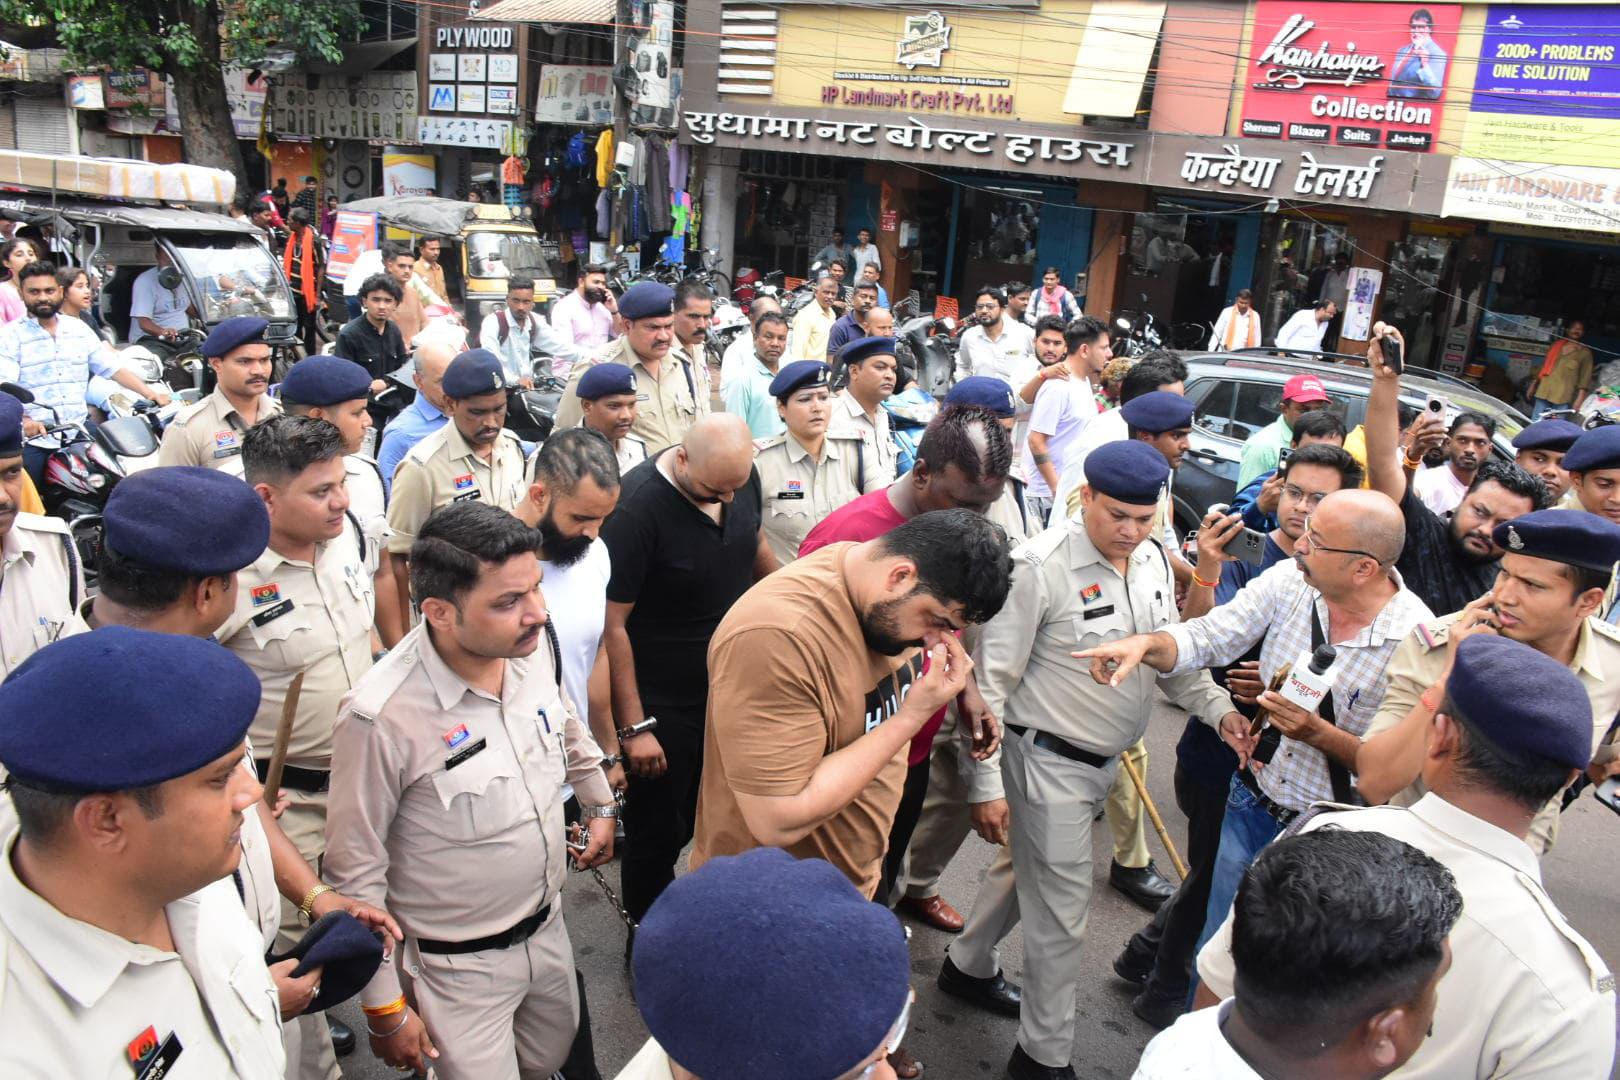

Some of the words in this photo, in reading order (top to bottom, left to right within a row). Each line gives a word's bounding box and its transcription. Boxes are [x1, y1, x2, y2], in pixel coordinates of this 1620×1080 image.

[437, 27, 512, 48] PLYWOOD
[1256, 14, 1385, 87] Kanhaiya
[1495, 43, 1538, 58] 2000+
[1540, 44, 1615, 61] PROBLEMS
[1492, 63, 1520, 78] ONE
[1522, 64, 1591, 81] SOLUTION
[821, 86, 840, 104] HP
[842, 86, 908, 108] Landmark
[911, 90, 949, 110] Craft
[953, 92, 984, 112] Pvt.
[988, 93, 1013, 114] Ltd
[1311, 94, 1432, 125] Collection
[1242, 121, 1281, 134] Sherwani
[1289, 124, 1328, 138] Blazer
[1343, 128, 1372, 142] Suits
[684, 110, 809, 145] सुधामा
[815, 119, 877, 145] नट
[886, 116, 995, 154] बोल्ट
[1005, 133, 1136, 167] हाउस
[1390, 134, 1426, 145] Jacket
[1180, 144, 1282, 191] कन्हैया
[1294, 151, 1384, 199] टेलर्स
[1495, 175, 1608, 204] HARDWARE
